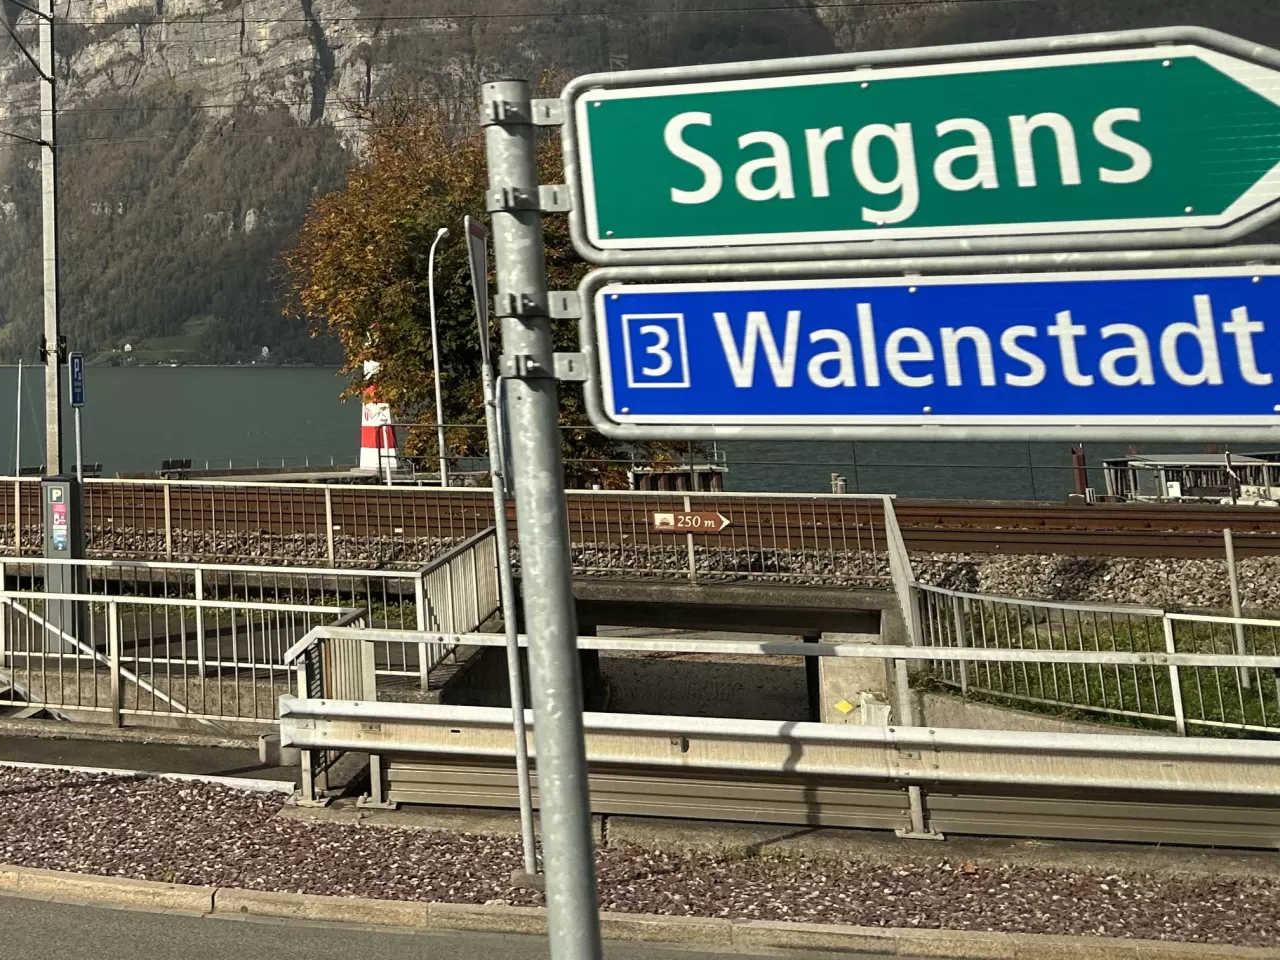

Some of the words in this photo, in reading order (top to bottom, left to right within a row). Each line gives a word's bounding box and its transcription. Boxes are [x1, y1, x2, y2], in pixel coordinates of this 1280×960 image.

[663, 107, 1153, 223] Sargans
[640, 324, 673, 377] 3
[712, 293, 1273, 388] Walenstadt
[52, 488, 62, 501] P
[677, 515, 701, 528] 250
[703, 519, 716, 528] m
